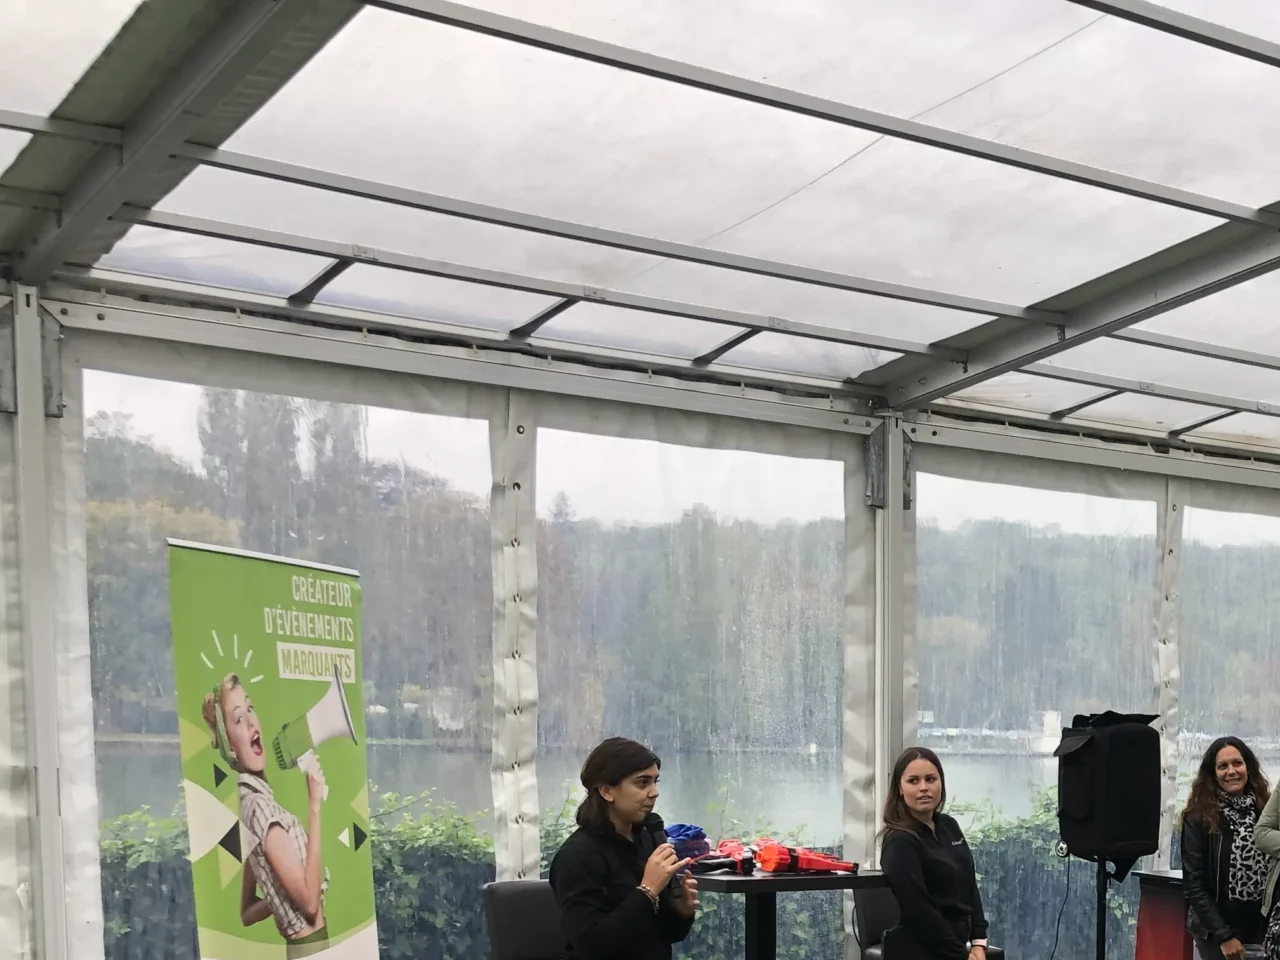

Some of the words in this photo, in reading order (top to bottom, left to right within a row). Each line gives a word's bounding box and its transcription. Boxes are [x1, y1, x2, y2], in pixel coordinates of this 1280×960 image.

[291, 573, 352, 608] CRÉATEUR
[263, 603, 355, 643] D'ÉVÈNEMENTS
[281, 648, 352, 679] MARQUANTS
